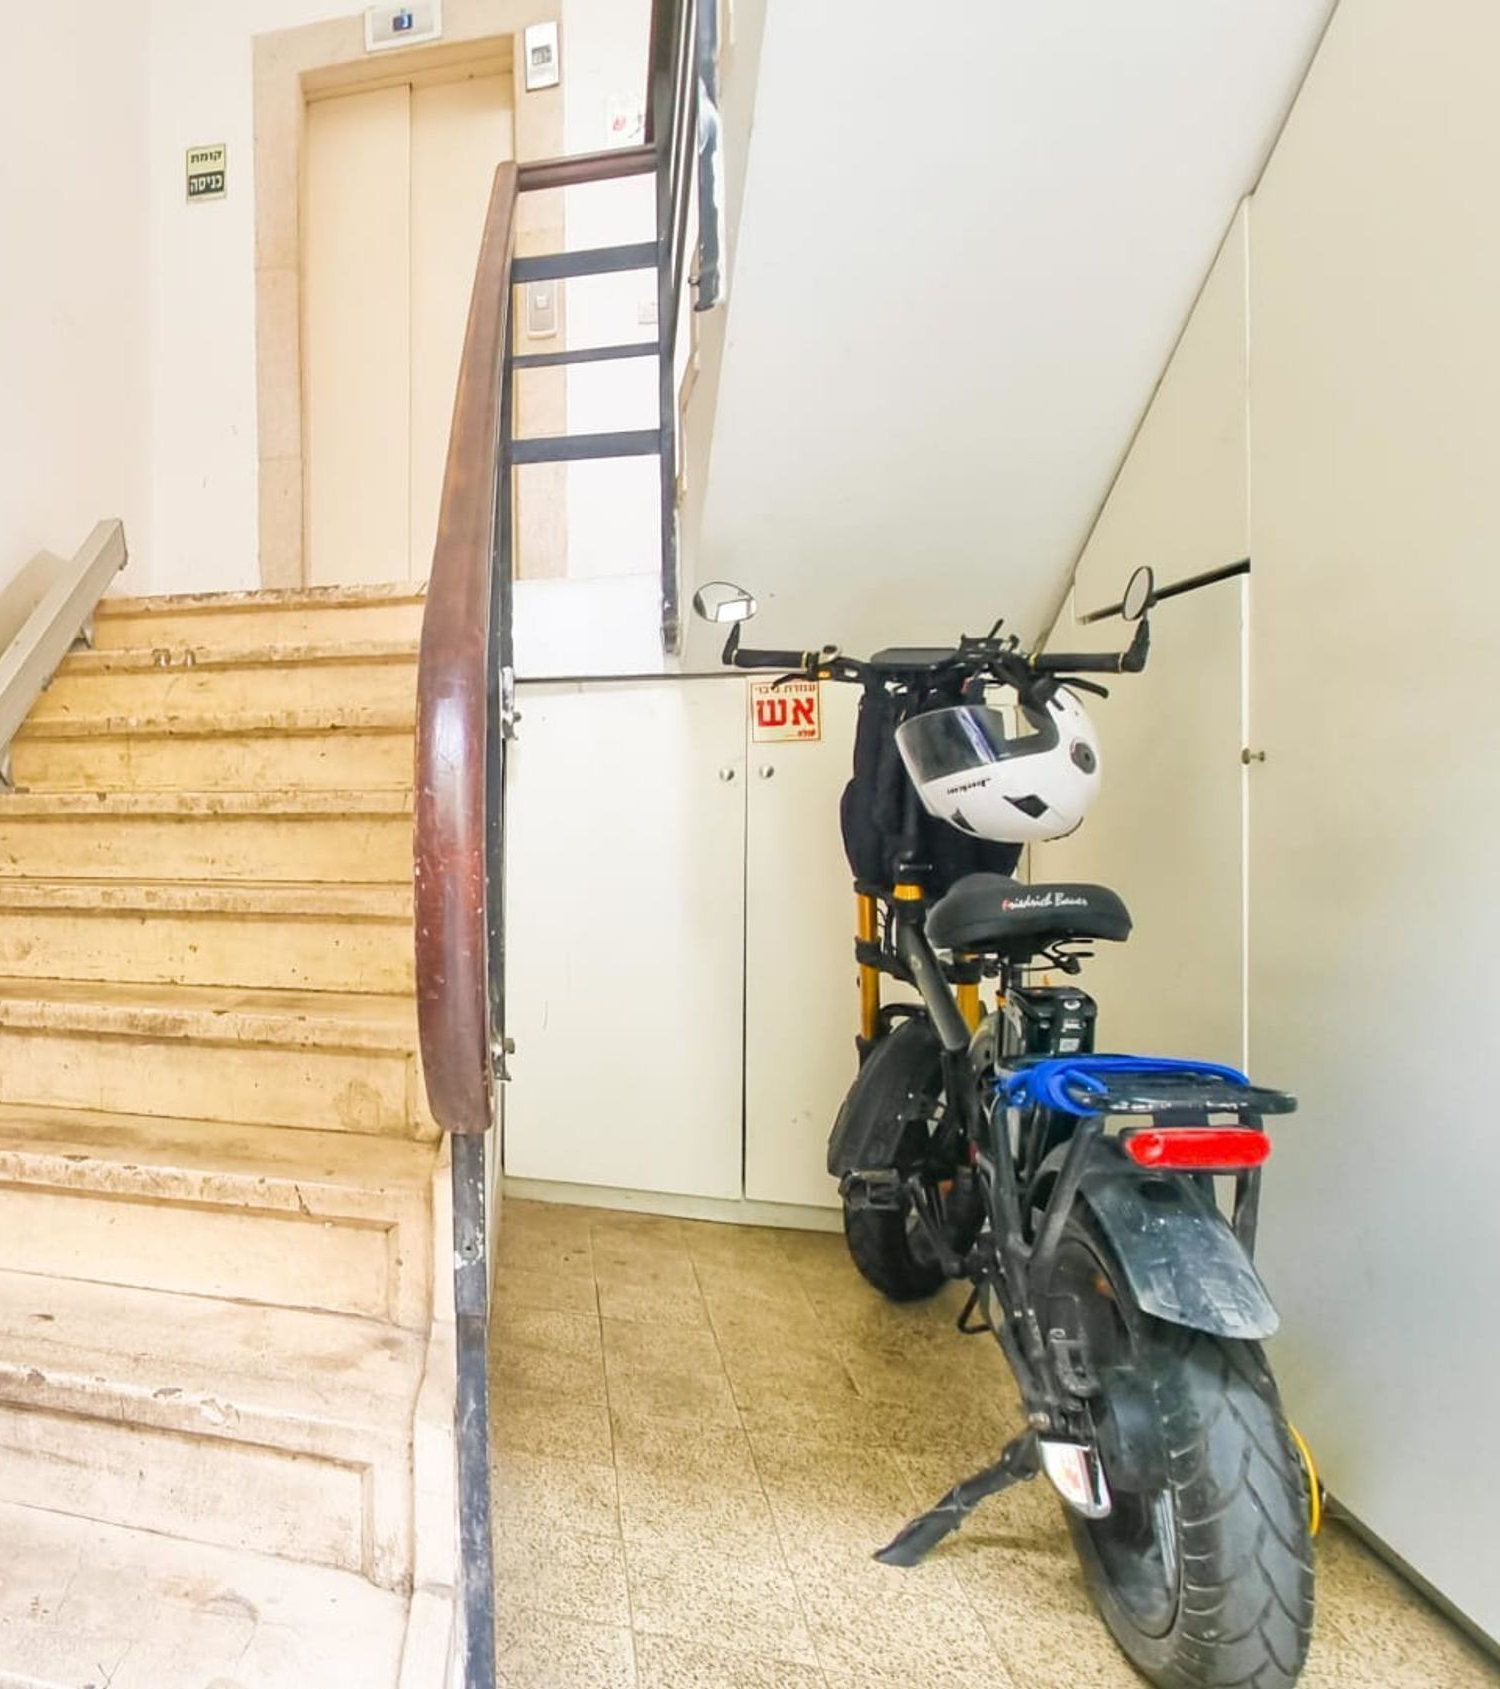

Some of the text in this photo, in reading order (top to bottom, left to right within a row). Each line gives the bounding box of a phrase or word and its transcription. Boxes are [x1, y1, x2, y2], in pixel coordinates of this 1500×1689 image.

[190, 150, 223, 164] קומת
[190, 175, 222, 193] כניסה
[756, 697, 815, 727] אש
